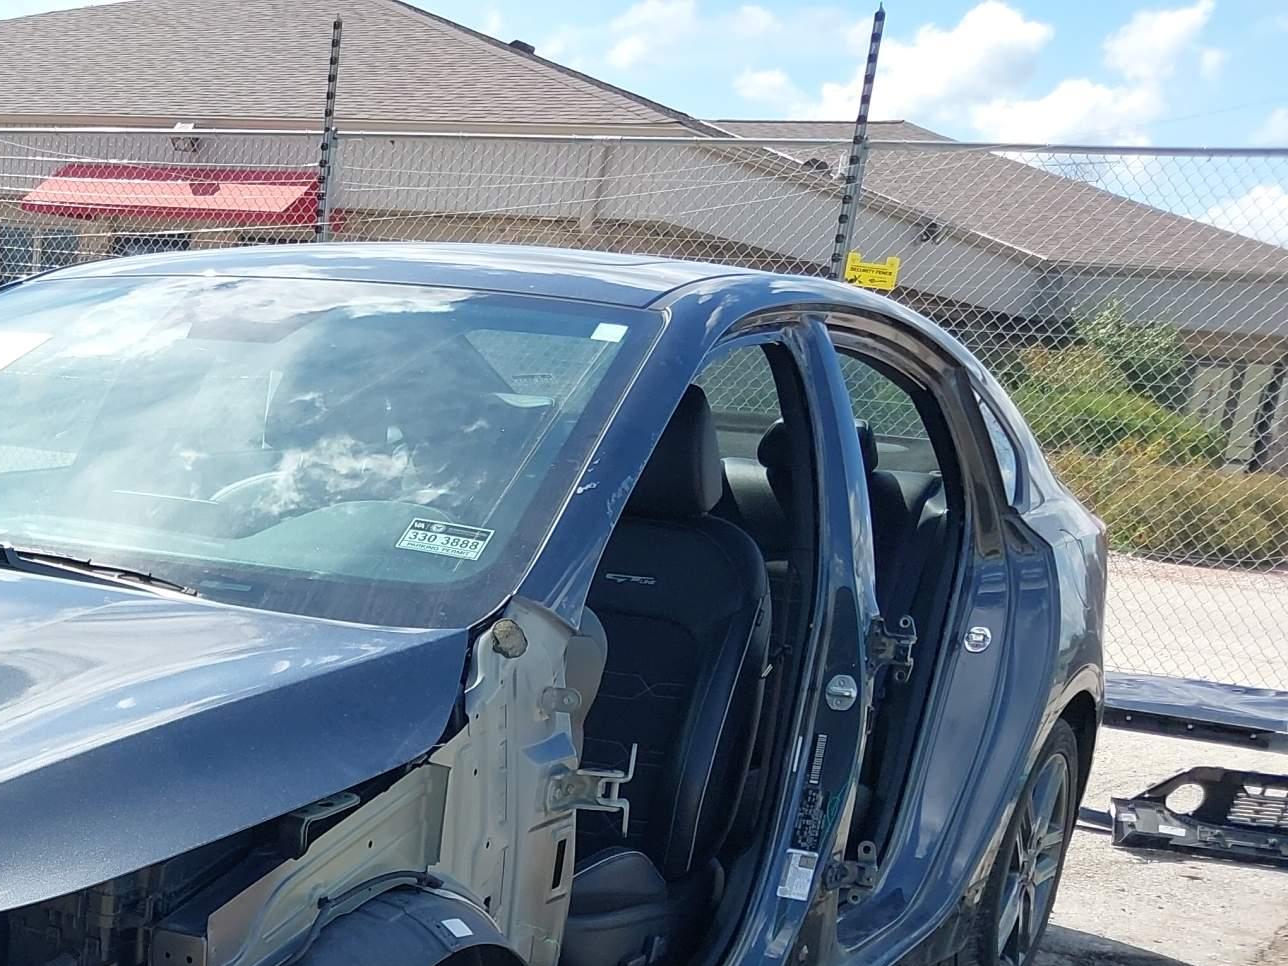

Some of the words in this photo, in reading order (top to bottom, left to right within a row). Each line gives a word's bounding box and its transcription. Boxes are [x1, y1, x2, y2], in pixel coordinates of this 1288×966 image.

[407, 542, 440, 551] PARKING
[441, 547, 470, 556] PERMIT
[408, 531, 438, 543] 330
[441, 536, 480, 551] 3888
